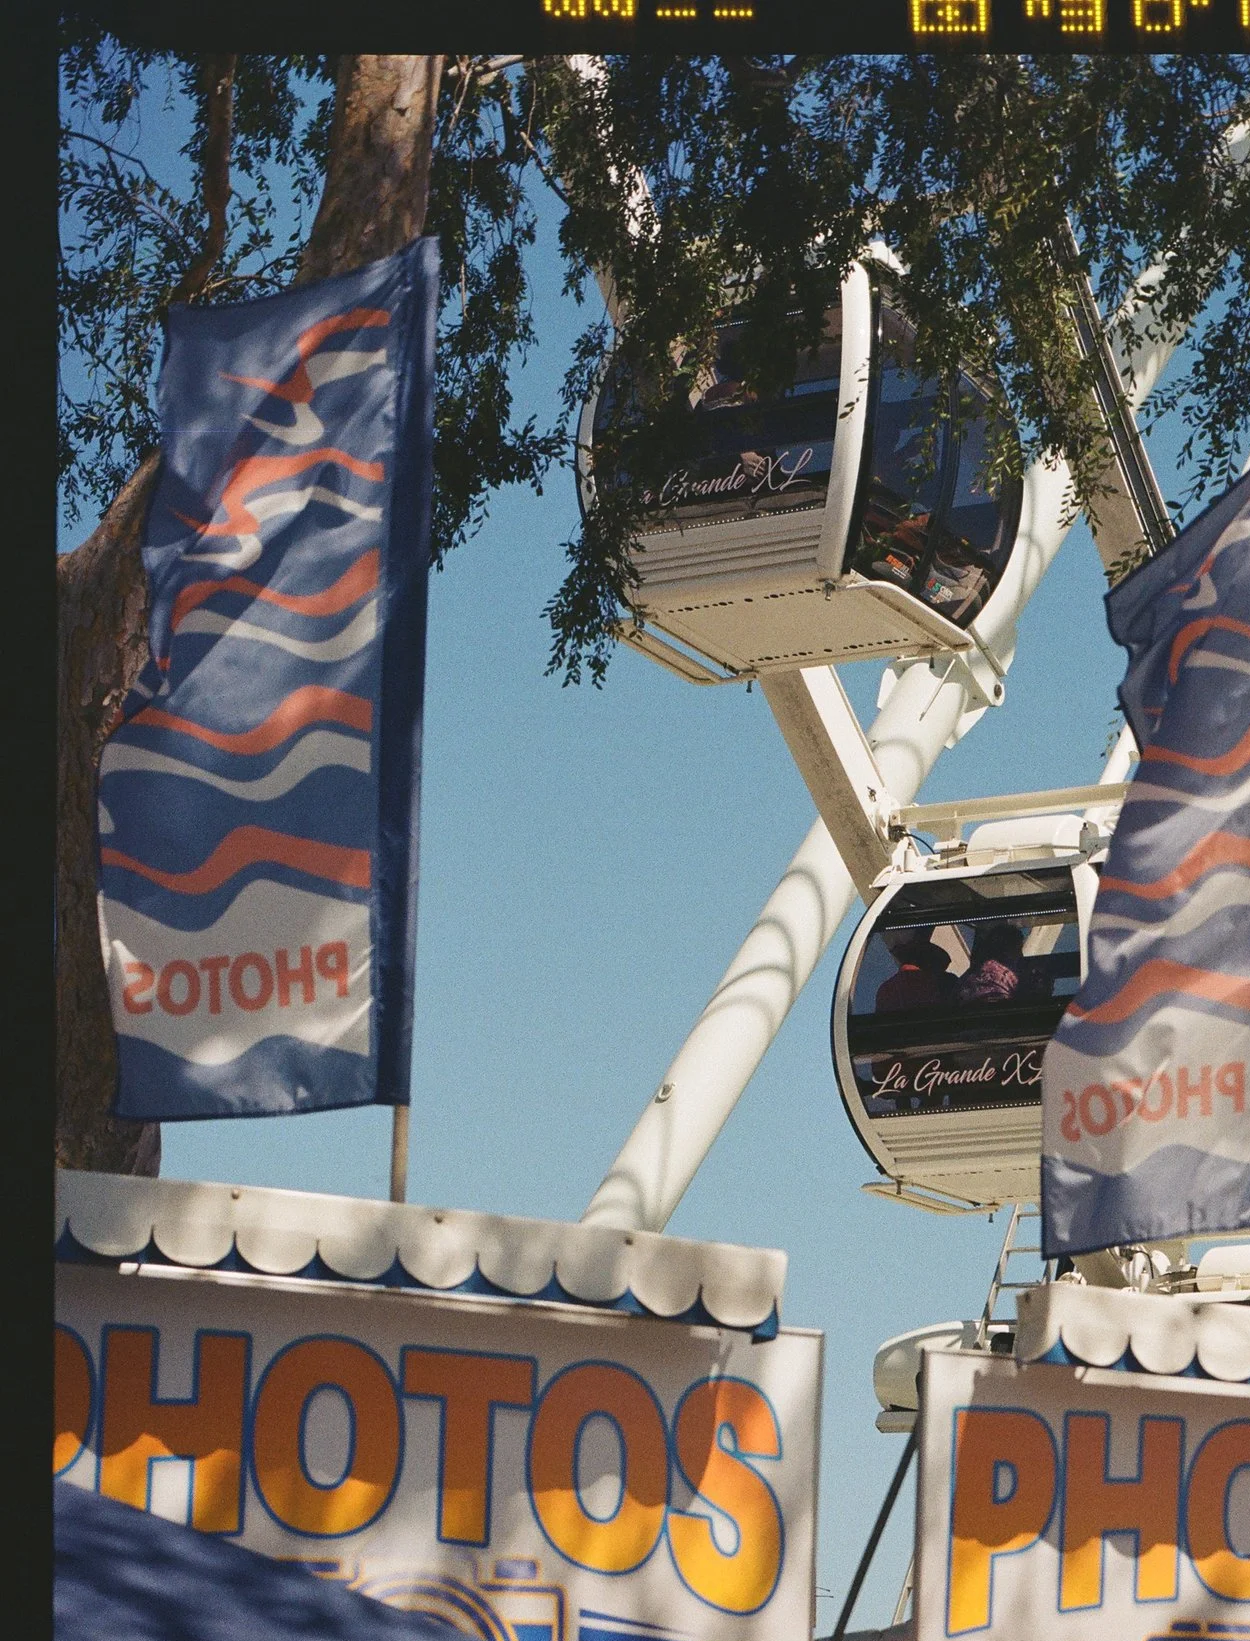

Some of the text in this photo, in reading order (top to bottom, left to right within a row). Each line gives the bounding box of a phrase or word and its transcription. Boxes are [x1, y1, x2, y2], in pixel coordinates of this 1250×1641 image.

[751, 448, 814, 493] XL
[872, 1062, 910, 1100] La
[913, 1057, 998, 1097] Grande
